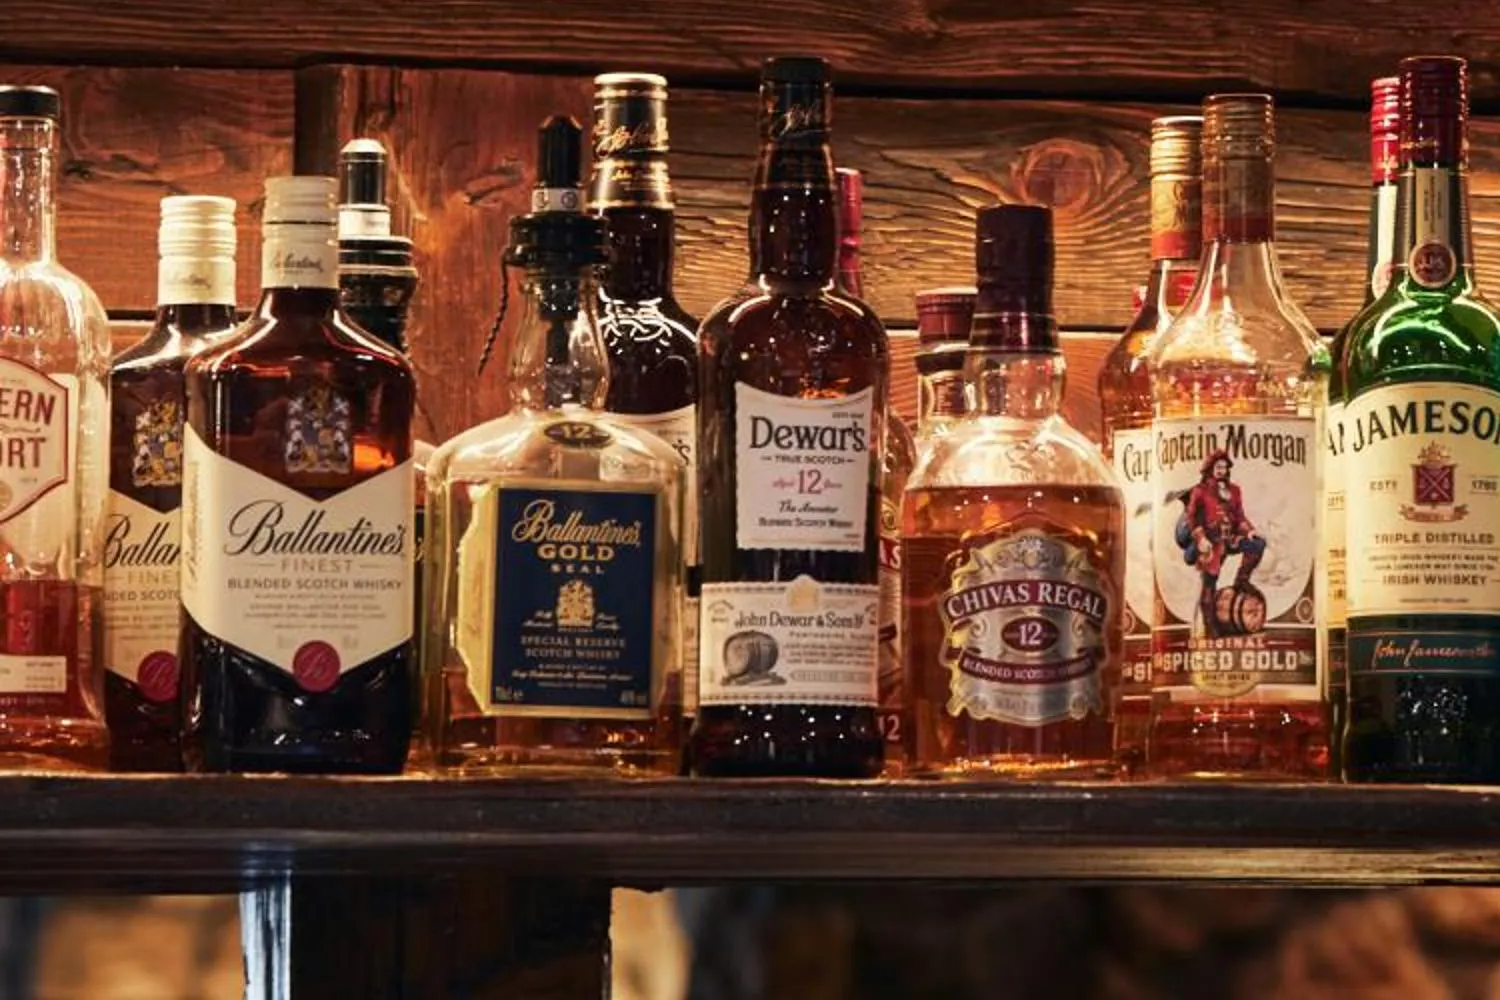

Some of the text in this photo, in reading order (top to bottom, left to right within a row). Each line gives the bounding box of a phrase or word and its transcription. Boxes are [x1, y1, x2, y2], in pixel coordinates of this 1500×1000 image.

[563, 423, 592, 440] 12
[749, 415, 867, 452] Dewar's
[0, 437, 46, 468] RT
[1156, 425, 1217, 472] Captain
[1220, 424, 1307, 467] Morgan
[798, 469, 822, 495] 12
[223, 499, 406, 558] Ballantine's
[511, 499, 642, 548] Ballantine's
[1375, 533, 1495, 544] TRIPLE DISTILLED
[538, 545, 616, 561] GOLD
[281, 559, 353, 573] FINEST
[550, 564, 605, 574] SEAL
[126, 570, 181, 585] FINE
[227, 578, 403, 592] BLENDED SCOTCH WHISKY
[1383, 574, 1488, 586] IRISH WHISKEY
[947, 582, 1102, 618] CHIVAS REGAL
[734, 611, 766, 628] John
[769, 611, 812, 628] Dewar
[1018, 622, 1042, 646] 12
[1188, 637, 1266, 649] ORIGINAL
[963, 658, 1013, 679] BLENDED
[1163, 651, 1234, 672] SPICED
[1241, 651, 1298, 672] GOLD
